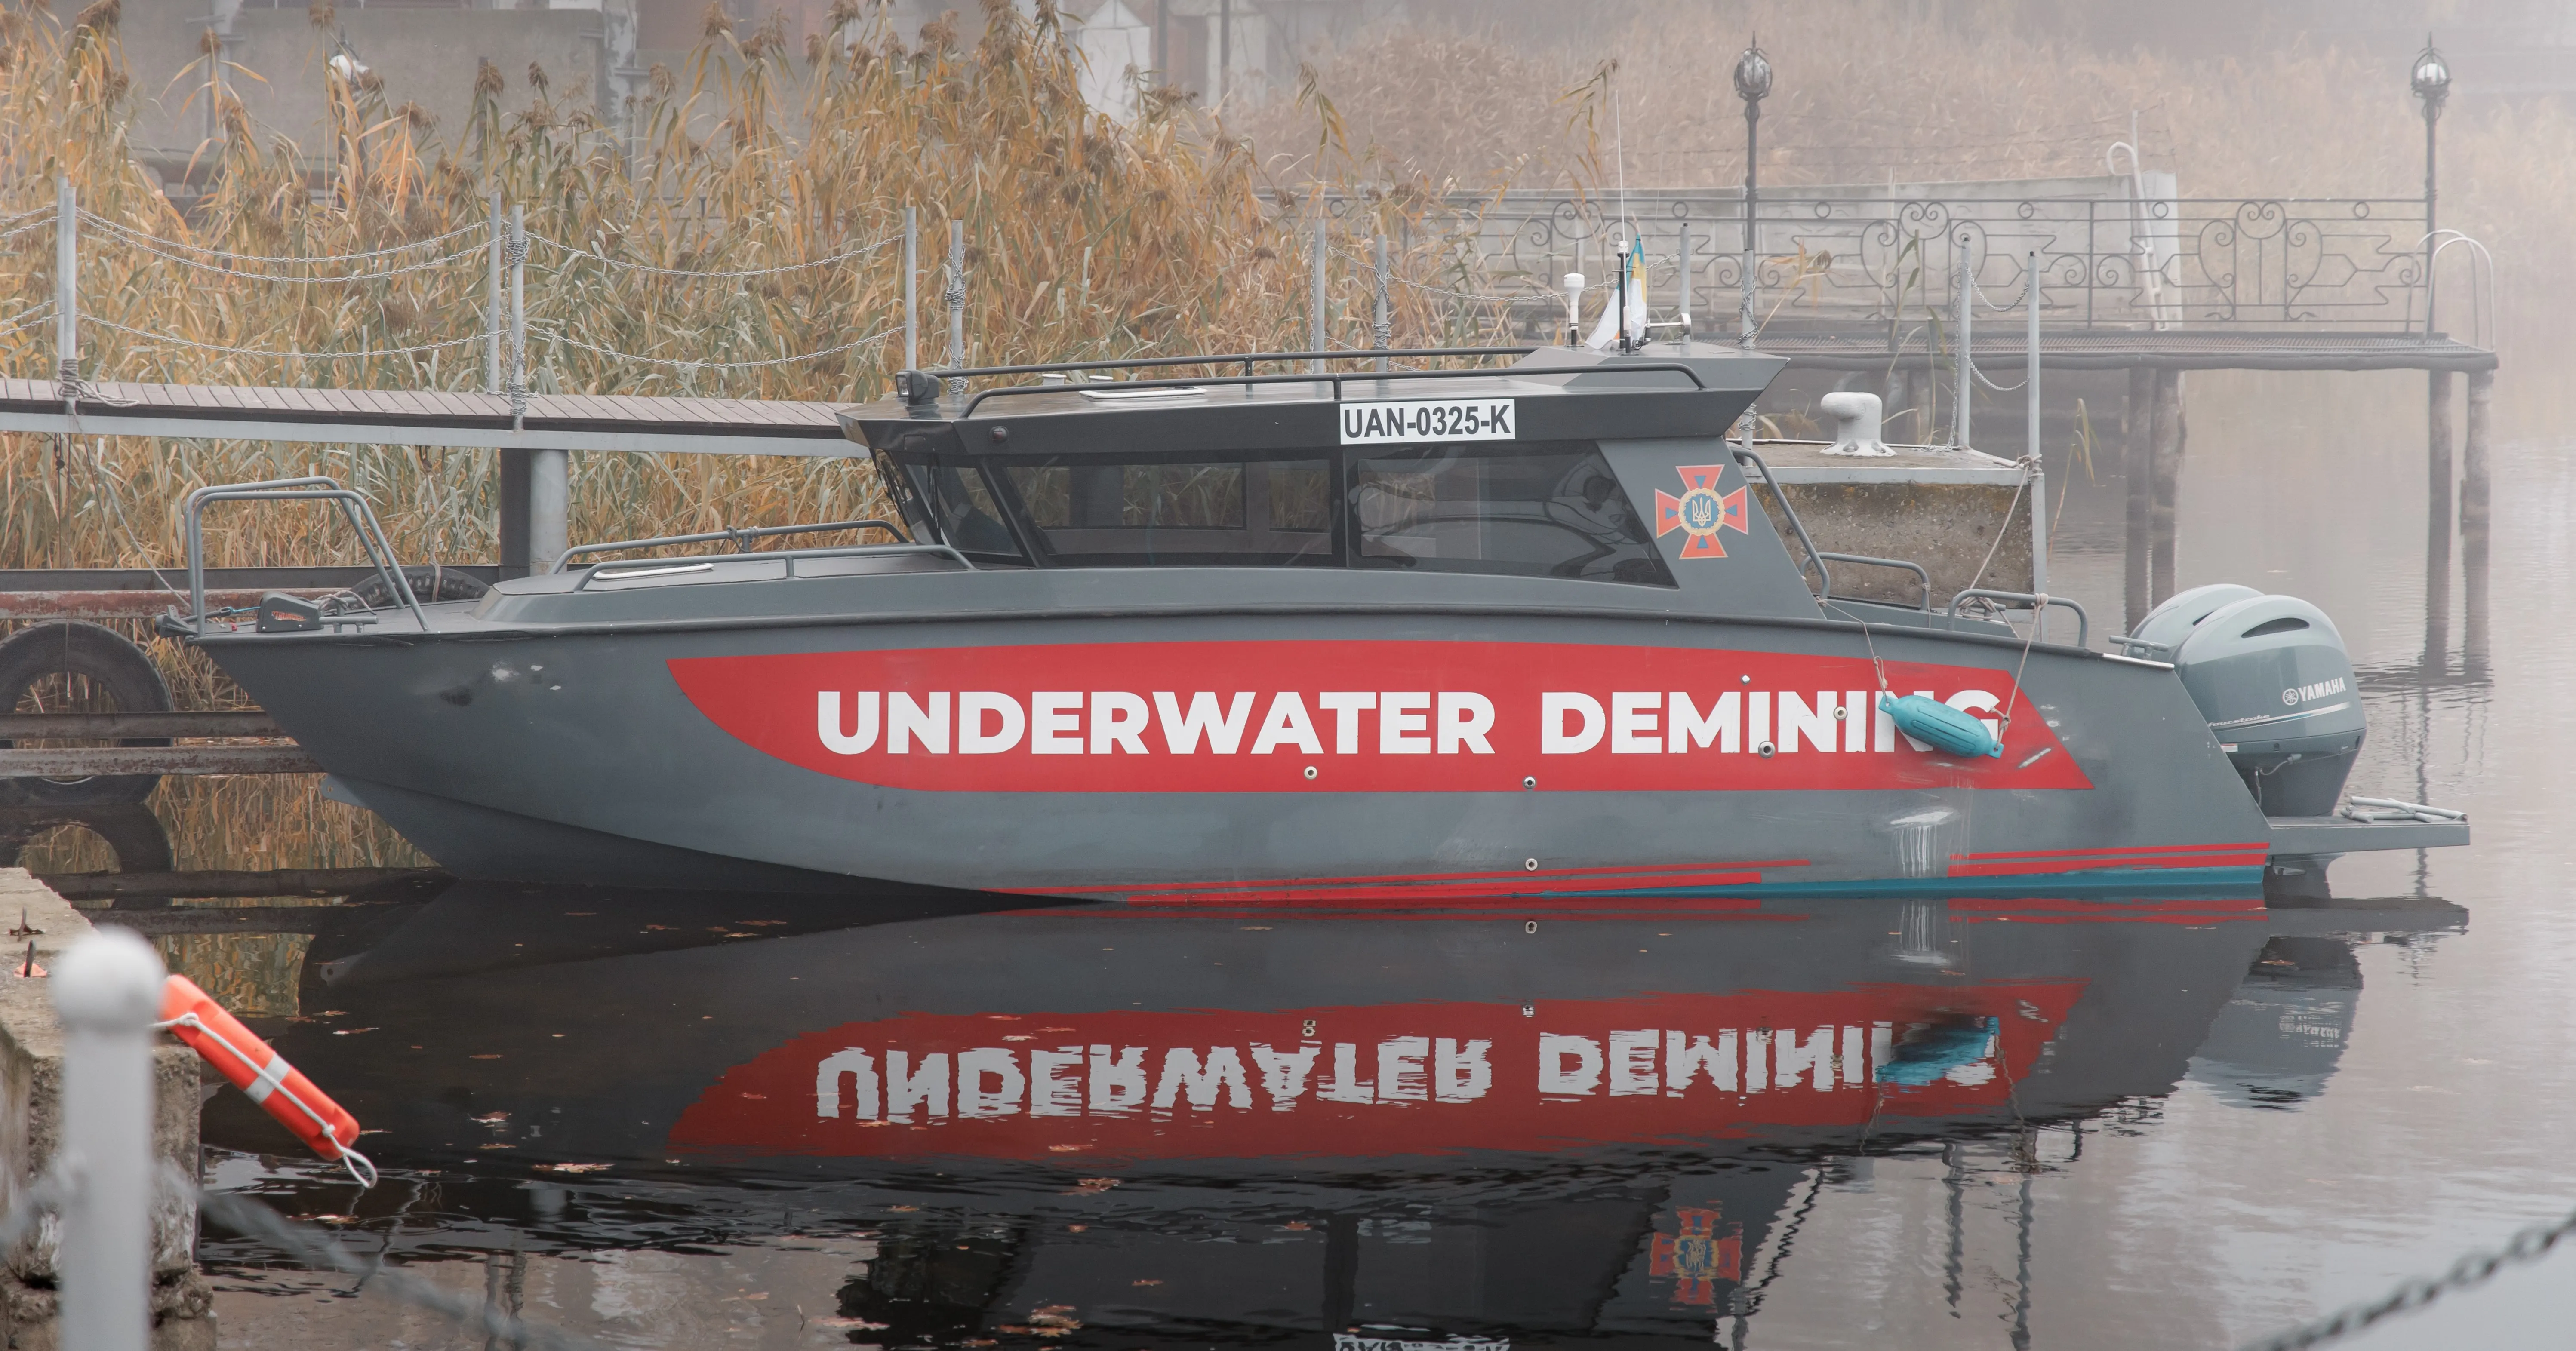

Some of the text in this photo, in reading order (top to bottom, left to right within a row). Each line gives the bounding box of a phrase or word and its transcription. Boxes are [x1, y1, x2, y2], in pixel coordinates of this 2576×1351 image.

[1344, 405, 1511, 438] UAN-0325-K
[2297, 677, 2347, 702] YAMAHA
[818, 691, 1496, 755] UNDERWATER
